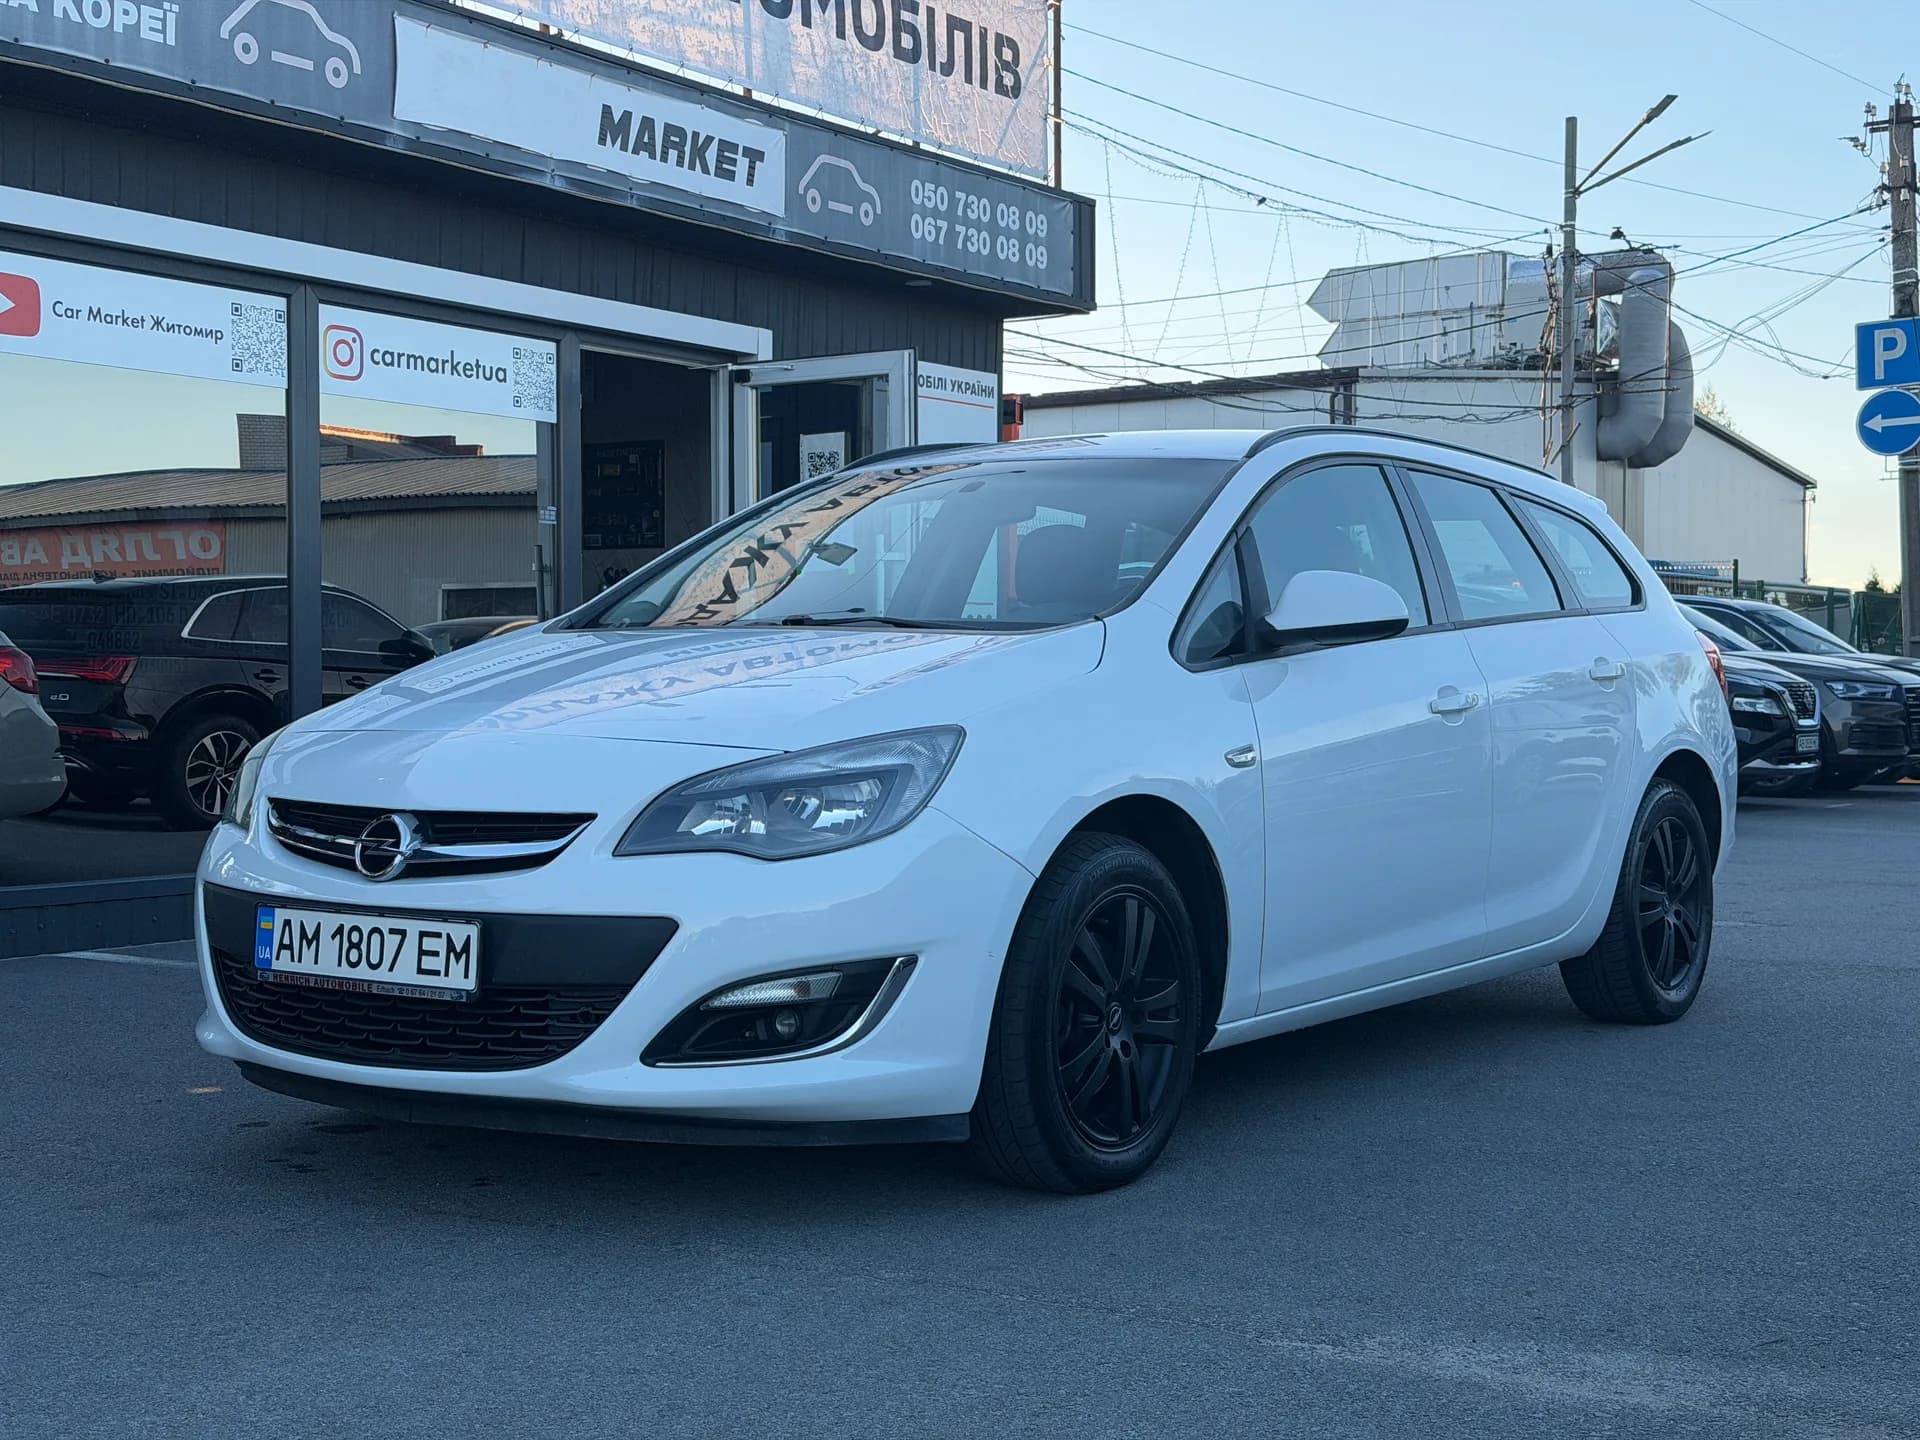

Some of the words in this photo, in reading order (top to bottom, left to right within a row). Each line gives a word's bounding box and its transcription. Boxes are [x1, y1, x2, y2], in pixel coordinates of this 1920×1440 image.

[53, 0, 180, 47] КОРЕЇ
[597, 103, 766, 188] MARKET
[910, 179, 948, 212] 050
[954, 191, 991, 223] 730
[996, 203, 1020, 231] 08
[1025, 210, 1048, 238] 09
[910, 213, 948, 246] 067
[954, 224, 991, 256] 730
[996, 235, 1020, 263] 08
[1025, 242, 1048, 270] 09
[52, 300, 82, 320] Car
[87, 305, 146, 330] Market
[150, 314, 224, 345] Житомир
[370, 347, 508, 384] carmarketua
[1874, 329, 1908, 380] P
[917, 374, 947, 392] ОБІЛІ
[950, 379, 995, 399] УКРАЇНИ
[258, 945, 272, 960] UA
[275, 918, 322, 966] AM
[330, 922, 408, 973] 1807
[416, 930, 472, 980] EM
[313, 976, 373, 993] AUTOMOBILE
